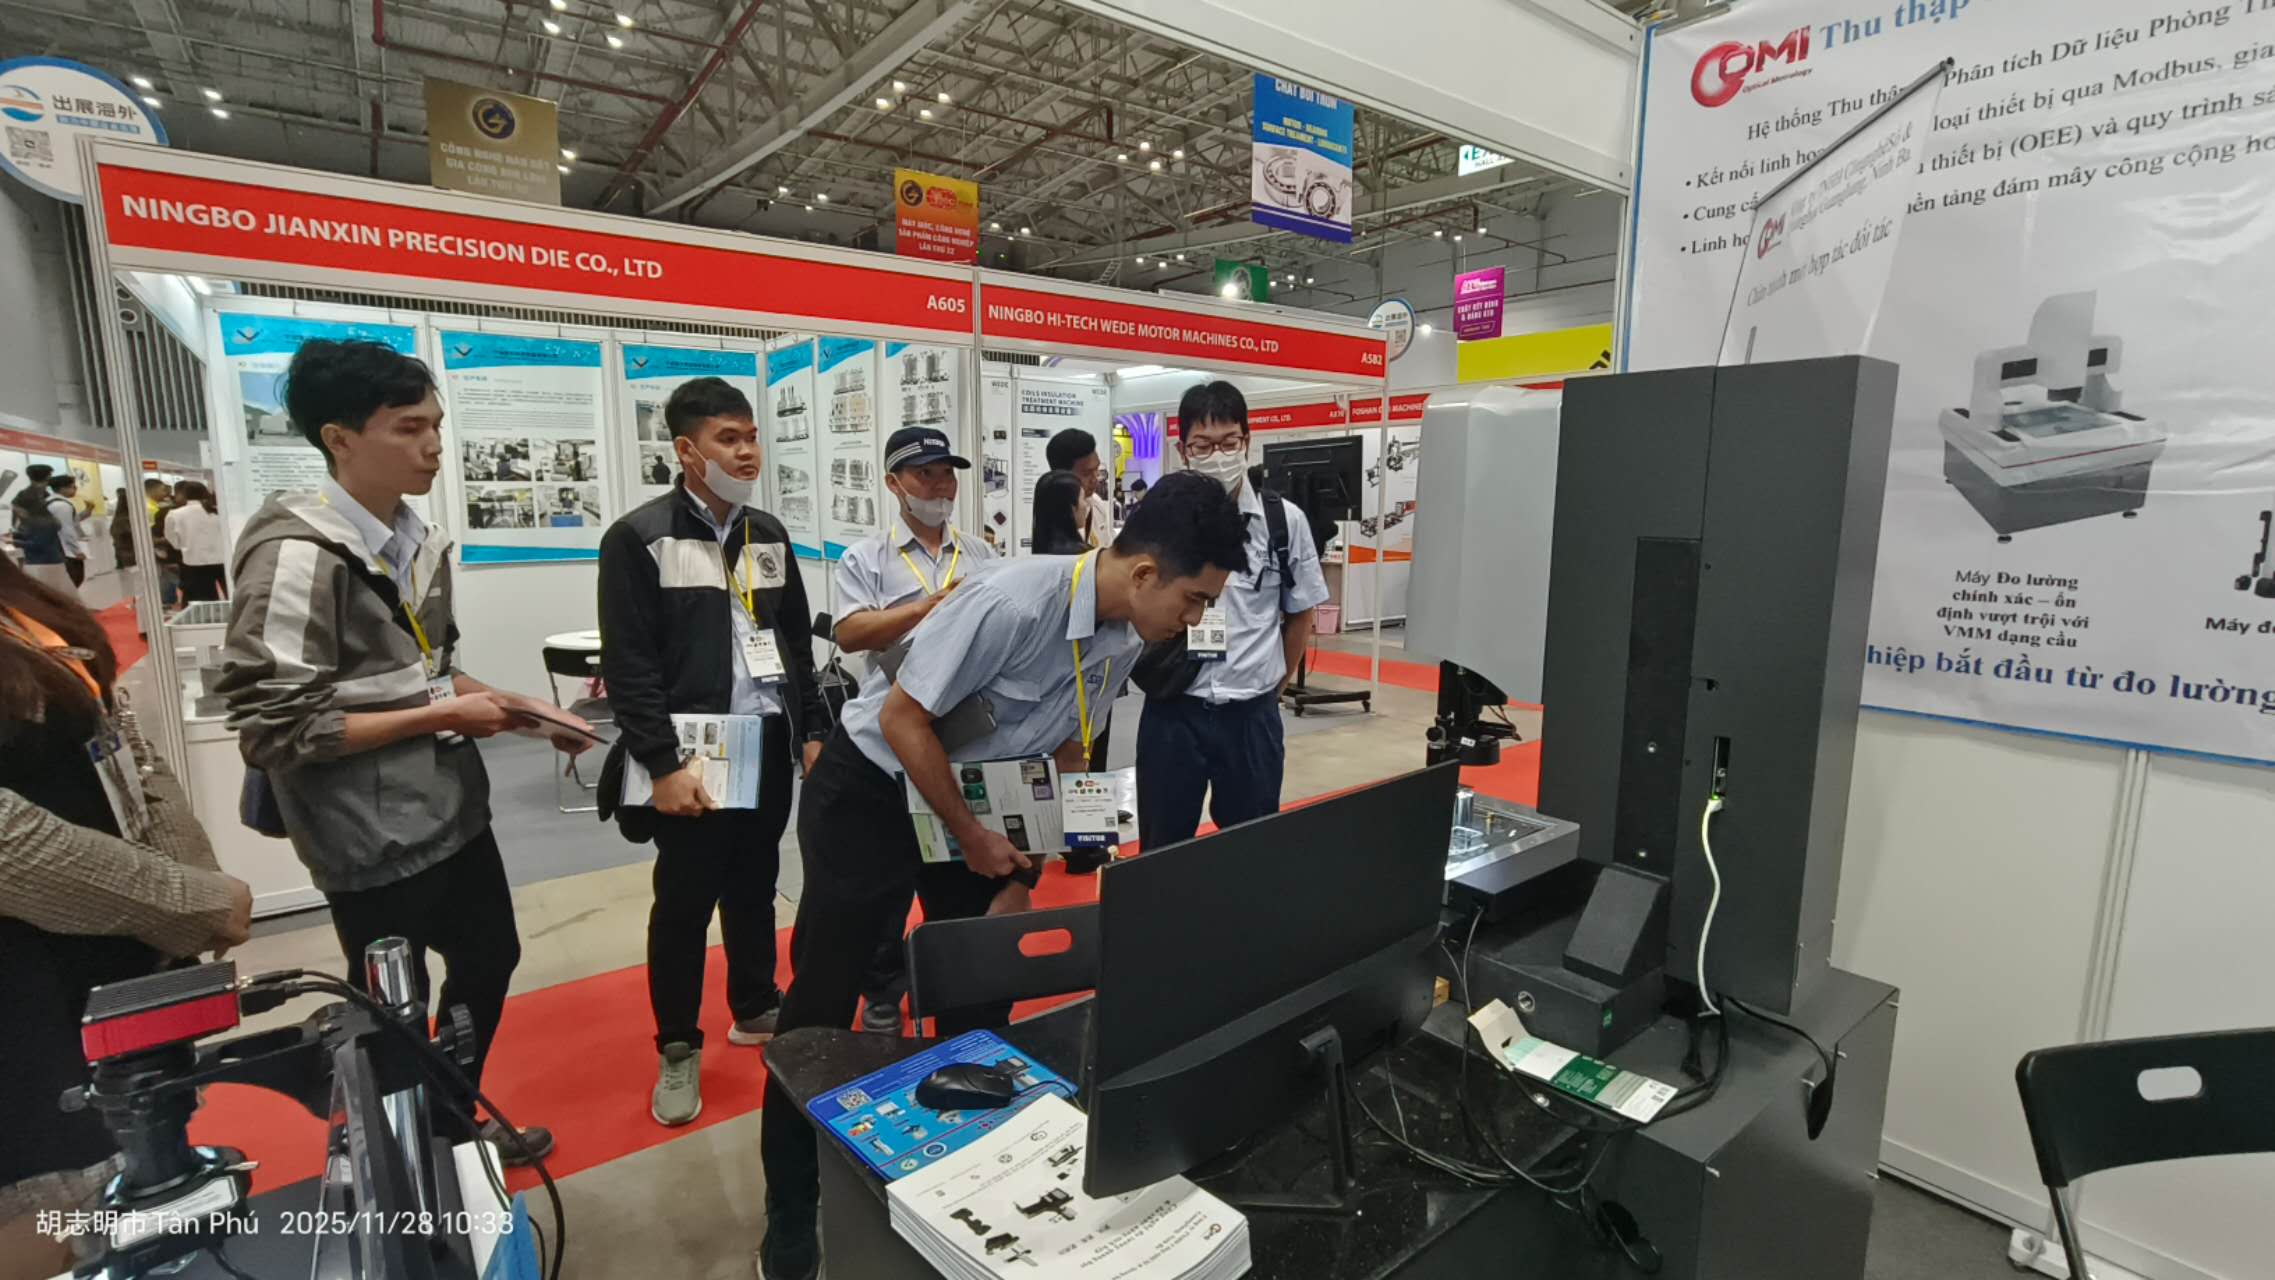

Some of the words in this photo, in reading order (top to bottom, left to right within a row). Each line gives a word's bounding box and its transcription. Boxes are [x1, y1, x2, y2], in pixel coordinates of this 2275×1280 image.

[1819, 16, 1881, 50] Thu
[1747, 122, 1770, 141] Hệ
[1775, 107, 1822, 133] thống
[1827, 98, 1863, 117] Thu
[1942, 64, 1994, 88] Phân
[2002, 49, 2043, 74] tích
[2052, 39, 2087, 62] Dữ
[2095, 29, 2140, 50] liệu
[2149, 5, 2231, 38] Phòng
[52, 94, 137, 120] 出展海外
[1696, 166, 1724, 188] Kết
[1729, 160, 1755, 182] nối
[1760, 152, 1791, 176] linh
[1933, 106, 1970, 132] loại
[1978, 91, 2025, 119] thiết
[2033, 89, 2054, 110] bị
[2061, 82, 2103, 104] qua
[1693, 204, 1736, 221] Cung
[1931, 143, 1975, 172] thiết
[1982, 142, 2003, 162] bị
[2010, 124, 2083, 158] (OEE)
[2091, 118, 2118, 138] và
[2126, 107, 2174, 134] quy
[2182, 92, 2243, 121] trình
[1692, 235, 1727, 254] Linh
[1942, 183, 1987, 208] tảng
[1993, 177, 2040, 198] đám
[2047, 166, 2097, 191] mây
[2105, 154, 2165, 178] công
[2173, 141, 2236, 168] cộng
[121, 194, 257, 231] NINGBO
[263, 213, 382, 247] JIANXIN
[388, 228, 525, 264] PRECISION
[530, 247, 571, 269] DIE
[575, 252, 619, 277] CO.,
[623, 258, 664, 279] LTD
[926, 295, 966, 313] A605
[988, 304, 1045, 326] NINGBO
[1046, 311, 1099, 331] HI-TECH
[1100, 317, 1136, 336] WEDE
[1137, 323, 1180, 342] MOTOR
[1181, 328, 1239, 348] MACHINES
[1239, 336, 1260, 353] CO.,
[1260, 339, 1279, 353] LTD
[1361, 352, 1383, 366] A582
[1022, 397, 1057, 405] TREATMENT
[1041, 391, 1076, 399] INSULATION
[1954, 570, 1991, 587] Máy
[1996, 571, 2021, 586] Đo
[2026, 573, 2079, 592] lường
[1952, 588, 1999, 605] chính
[2004, 591, 2033, 606] xác
[2054, 592, 2077, 609] ổn
[1936, 606, 1973, 623] định
[1979, 610, 2018, 626] vượt
[2023, 612, 2056, 629] trội
[2060, 614, 2090, 630] với
[2205, 617, 2251, 635] Máy
[1943, 625, 1992, 641] VMM
[1998, 629, 2042, 648] dạng
[2046, 629, 2078, 649] cầu
[1936, 648, 1983, 677] bắt
[1993, 653, 2053, 685] đầu
[2066, 665, 2103, 690] từ
[2112, 670, 2157, 694] đo
[2169, 675, 2275, 715] lường
[1077, 834, 1105, 842] VISITOR
